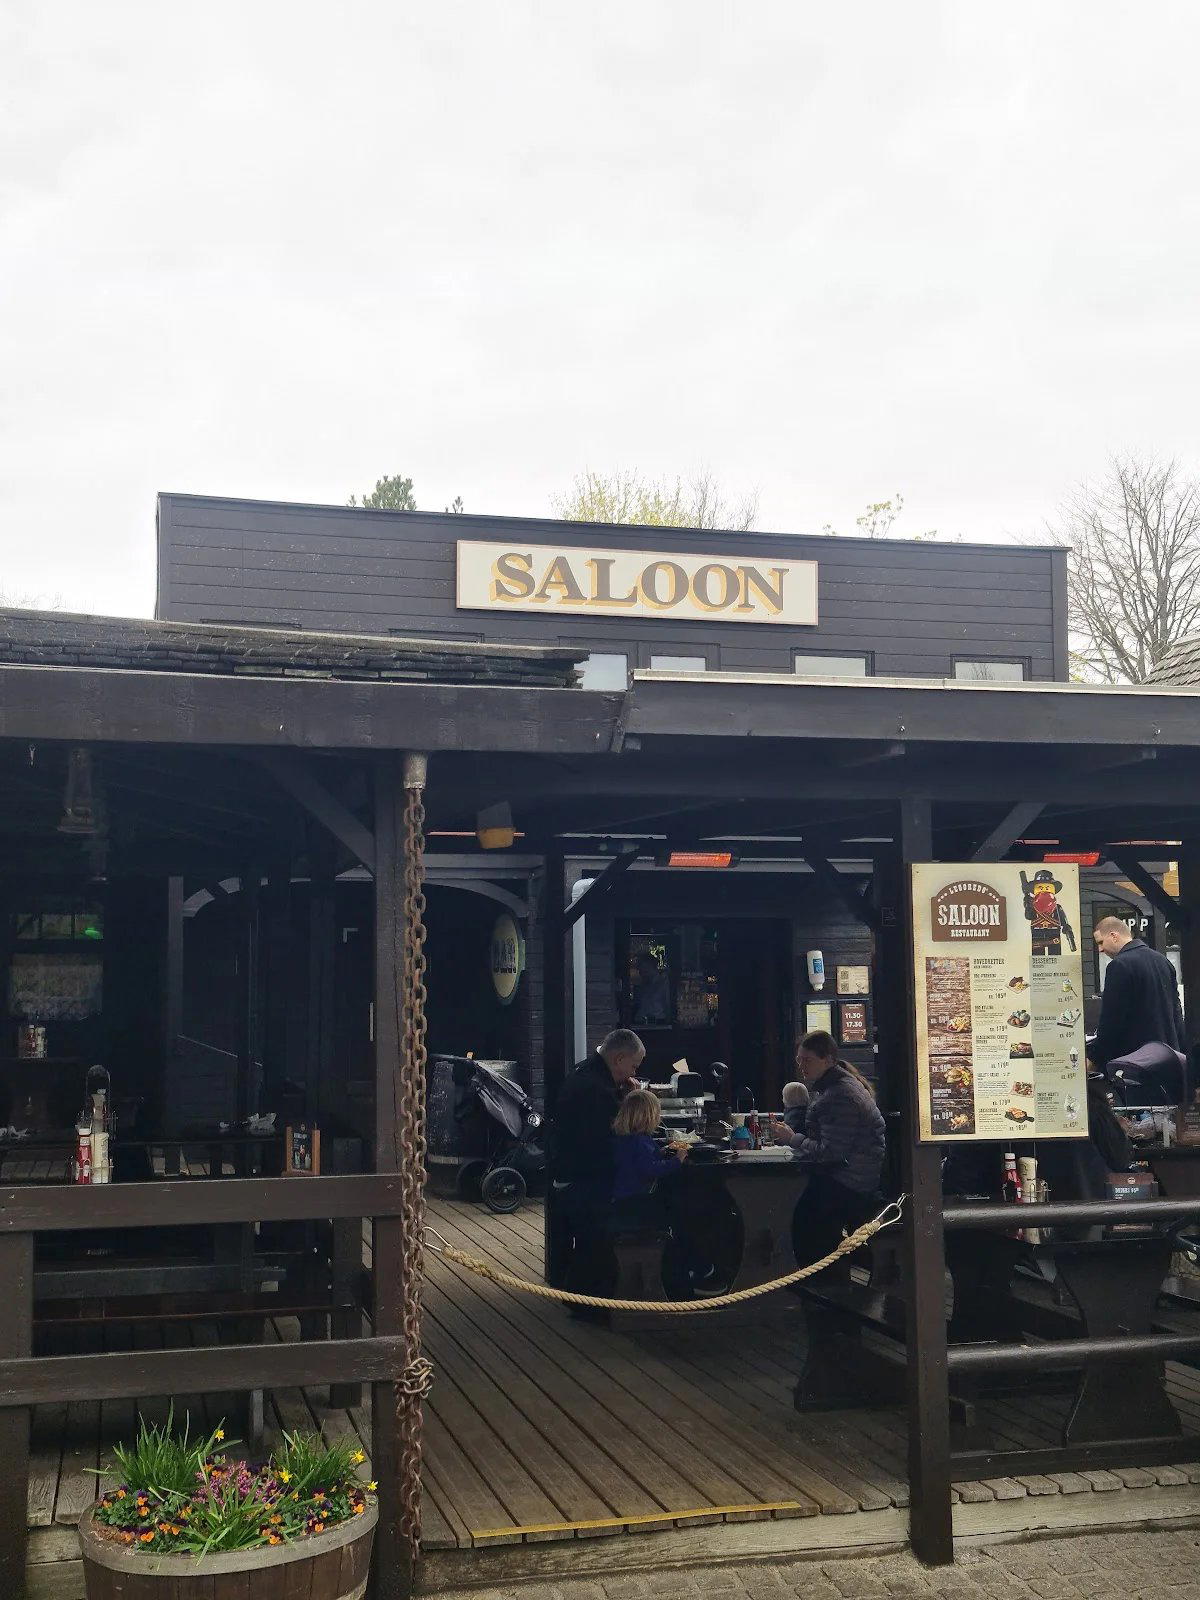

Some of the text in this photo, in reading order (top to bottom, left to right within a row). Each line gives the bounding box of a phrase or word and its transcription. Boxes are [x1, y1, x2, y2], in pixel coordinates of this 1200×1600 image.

[490, 552, 789, 615] SALOON
[938, 904, 1001, 926] SALOON
[950, 929, 990, 938] RESTAURANT
